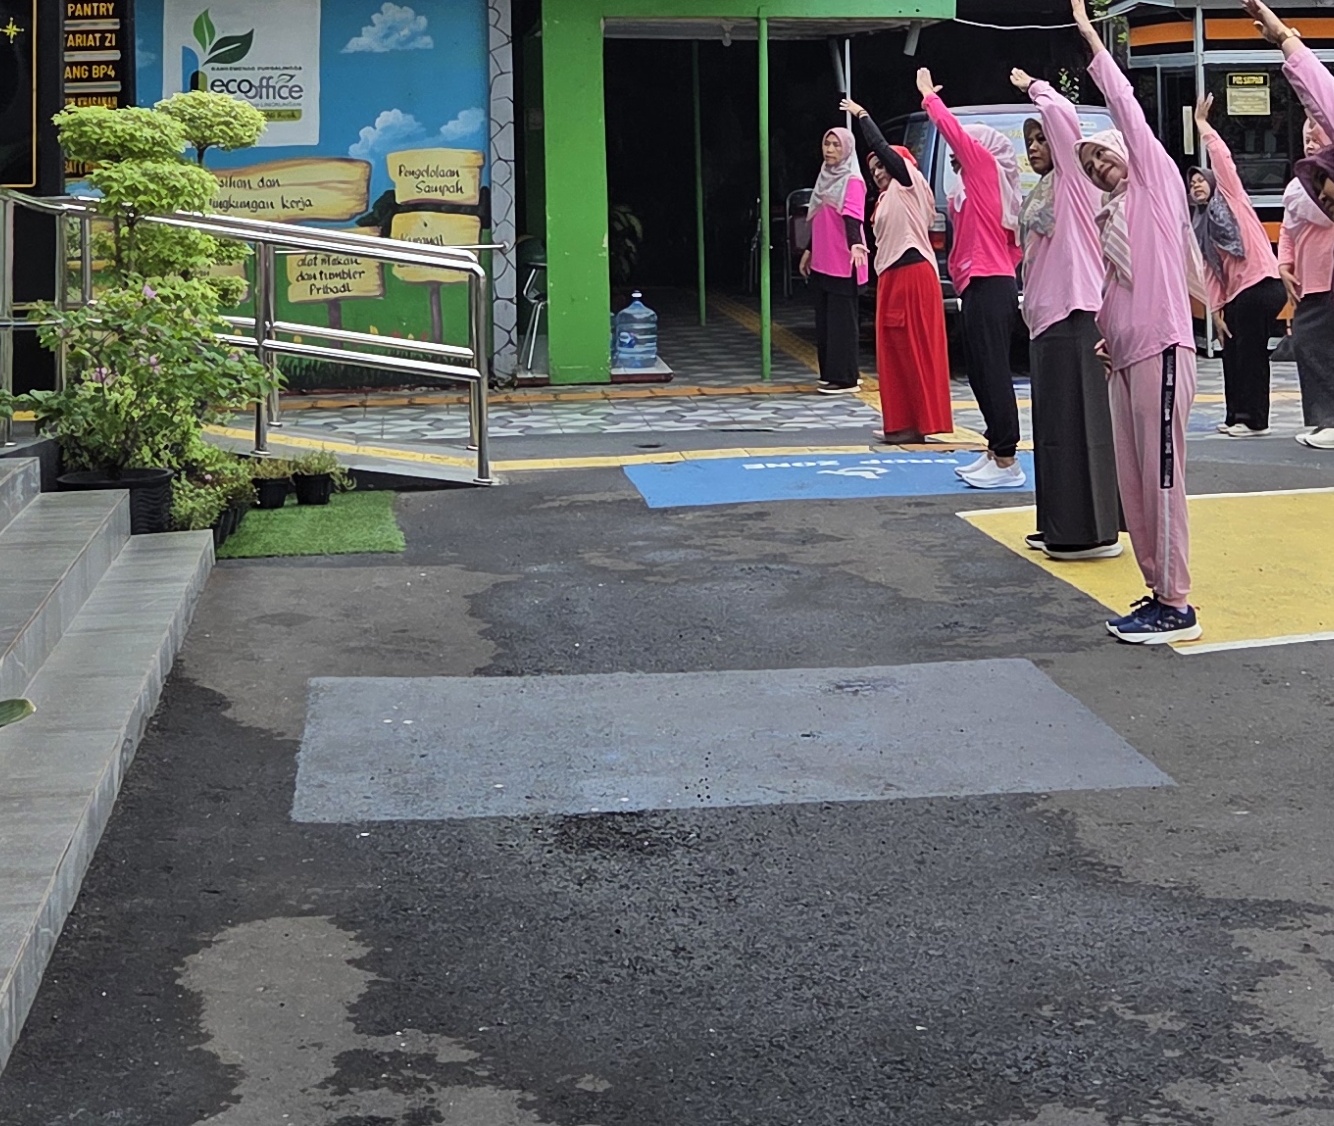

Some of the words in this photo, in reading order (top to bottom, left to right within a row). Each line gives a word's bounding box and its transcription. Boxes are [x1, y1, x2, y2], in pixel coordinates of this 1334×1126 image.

[67, 2, 115, 17] PANTRY
[104, 33, 116, 47] ZI
[91, 65, 116, 79] BP4
[257, 176, 281, 189] dan
[415, 180, 465, 196] Sampah
[281, 195, 314, 213] kerja
